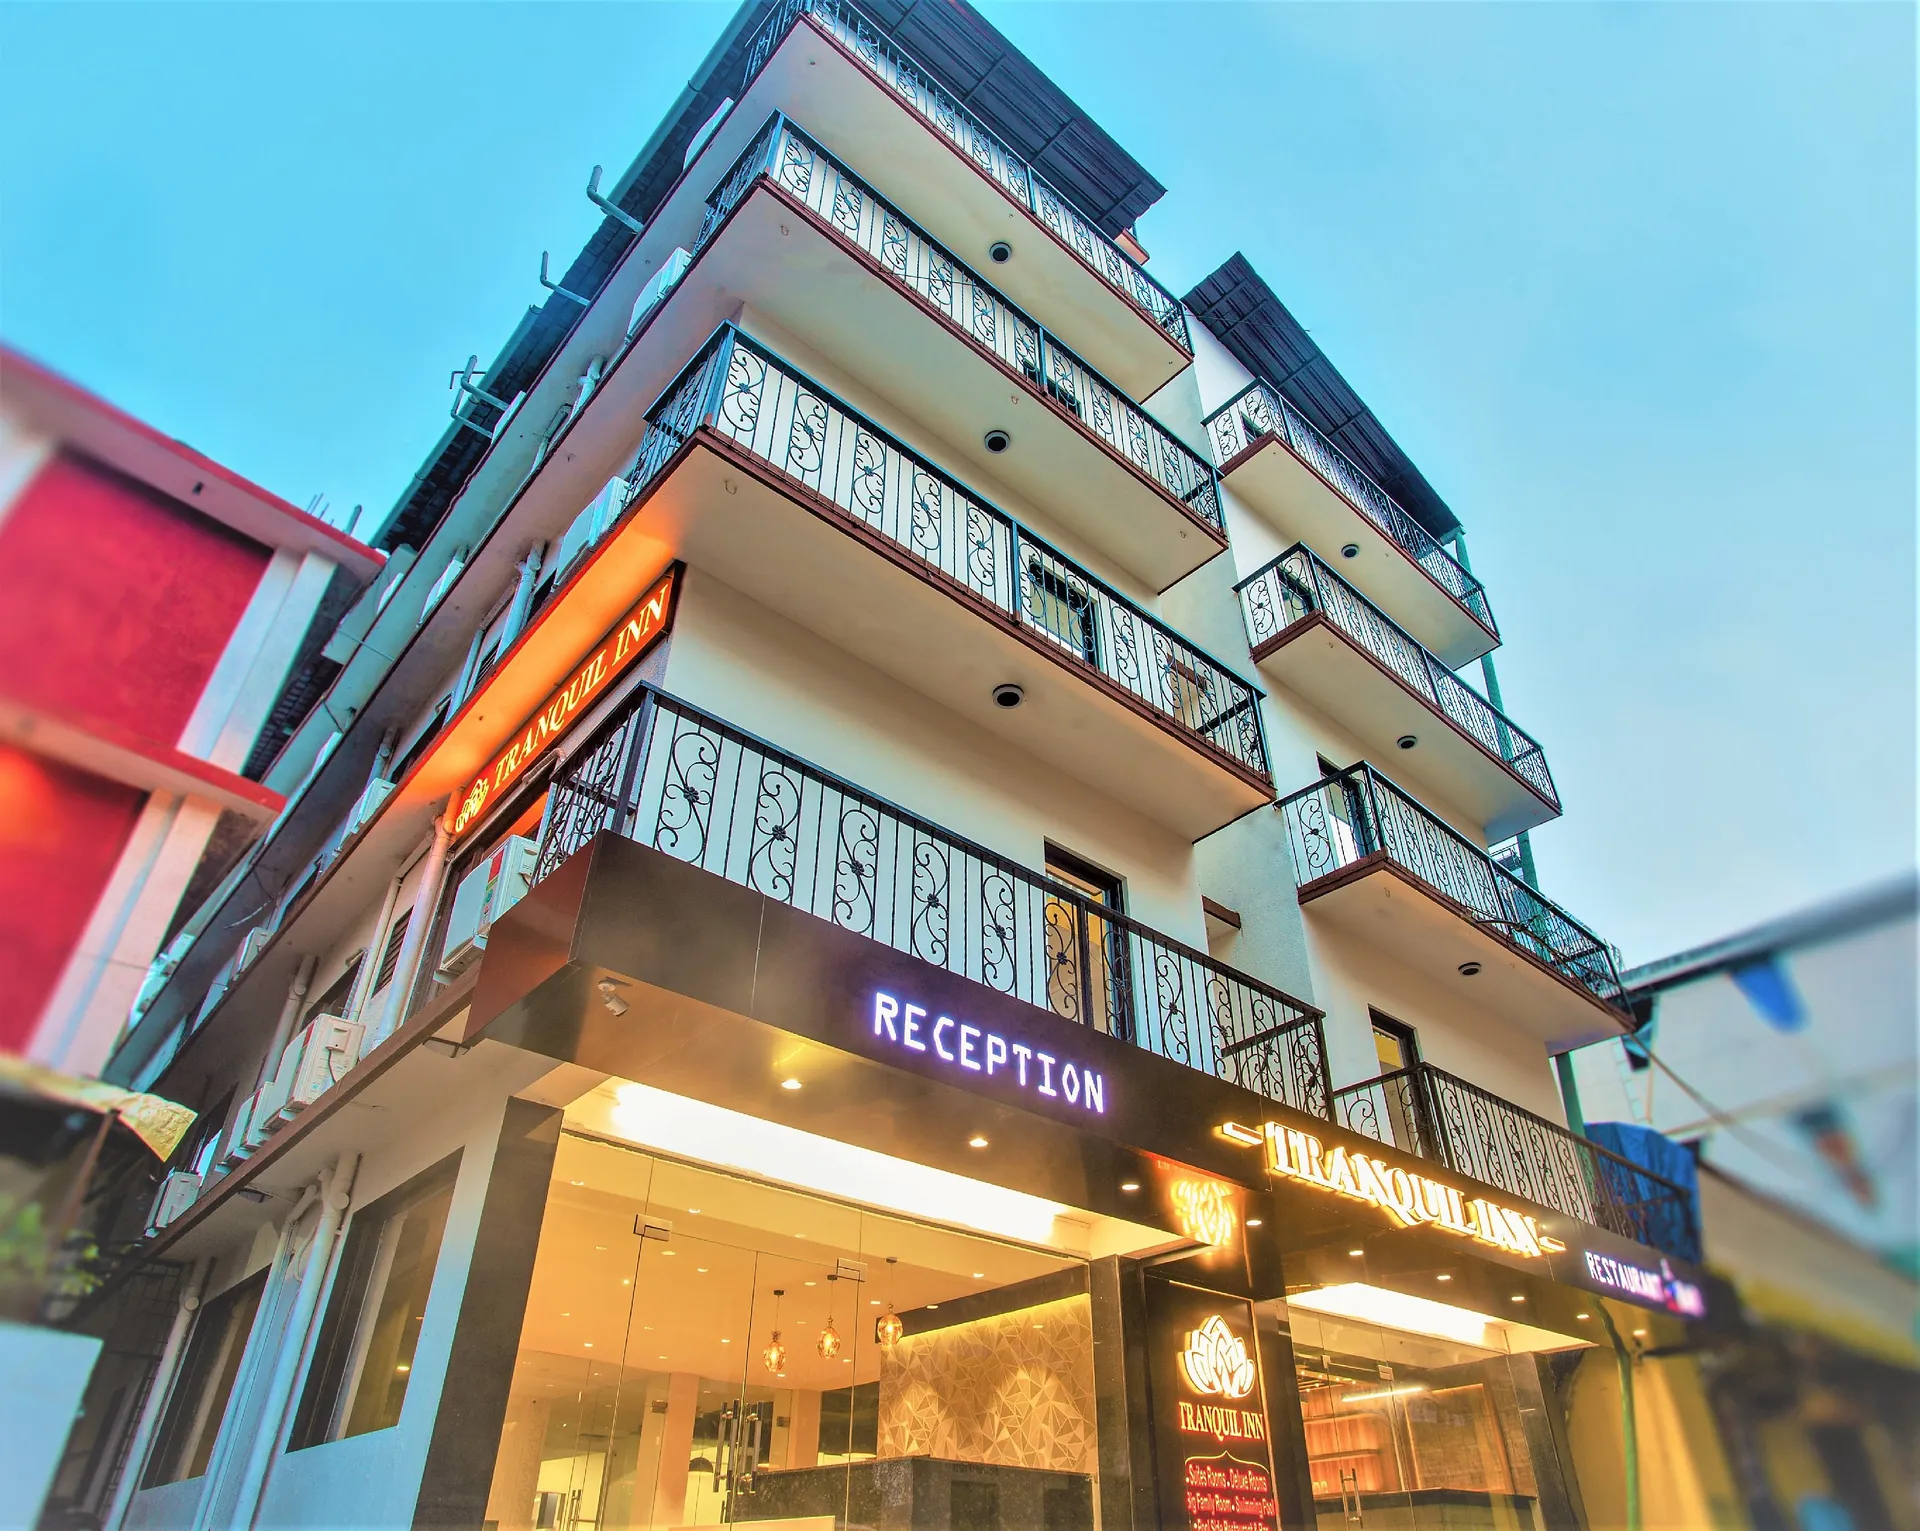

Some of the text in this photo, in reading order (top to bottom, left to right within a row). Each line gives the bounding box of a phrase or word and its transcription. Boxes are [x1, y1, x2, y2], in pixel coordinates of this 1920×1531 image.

[493, 584, 668, 791] TRANQUIL INN
[874, 992, 1104, 1113] RECEPTION
[1265, 1121, 1542, 1257] TRANQUIL INN
[1585, 1250, 1665, 1302] RESTAURANT
[1179, 1401, 1265, 1442] TRANQUIL INN
[1188, 1463, 1268, 1493] Suites Rooms Deluxe Rooms
[1262, 1498, 1275, 1515] Pool
